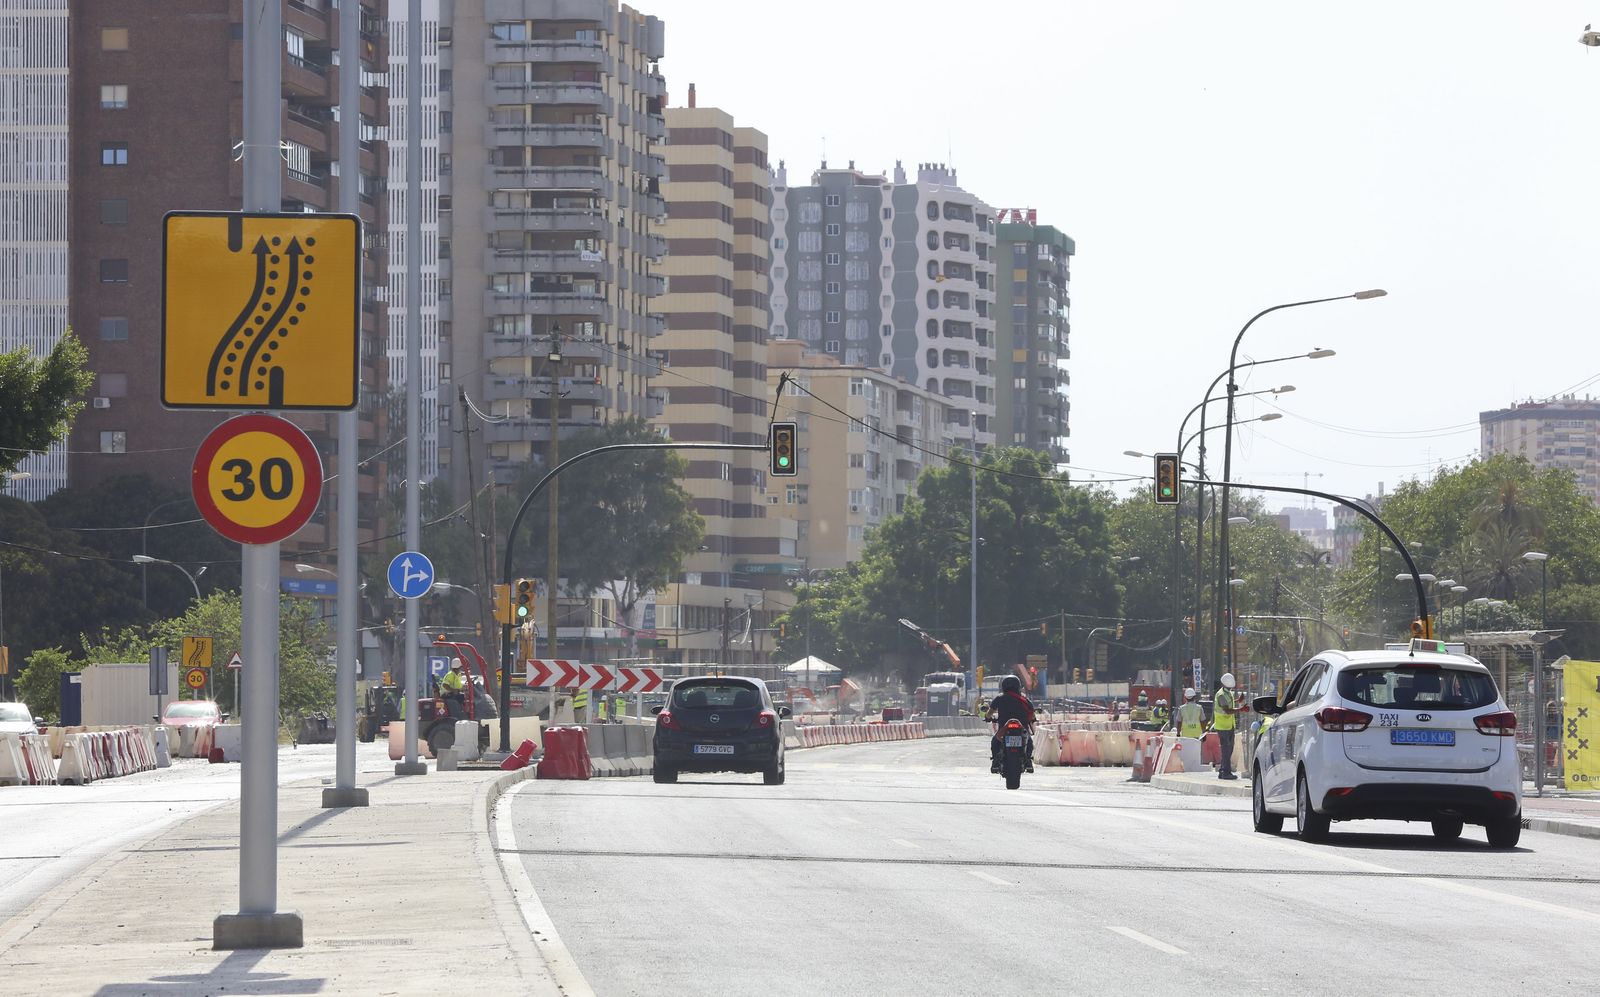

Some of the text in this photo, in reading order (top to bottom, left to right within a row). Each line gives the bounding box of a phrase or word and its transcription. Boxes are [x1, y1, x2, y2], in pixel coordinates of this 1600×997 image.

[221, 457, 294, 502] 30
[432, 660, 443, 674] P
[190, 675, 203, 683] 30
[1399, 731, 1428, 742] 3650
[700, 745, 717, 753] 5779
